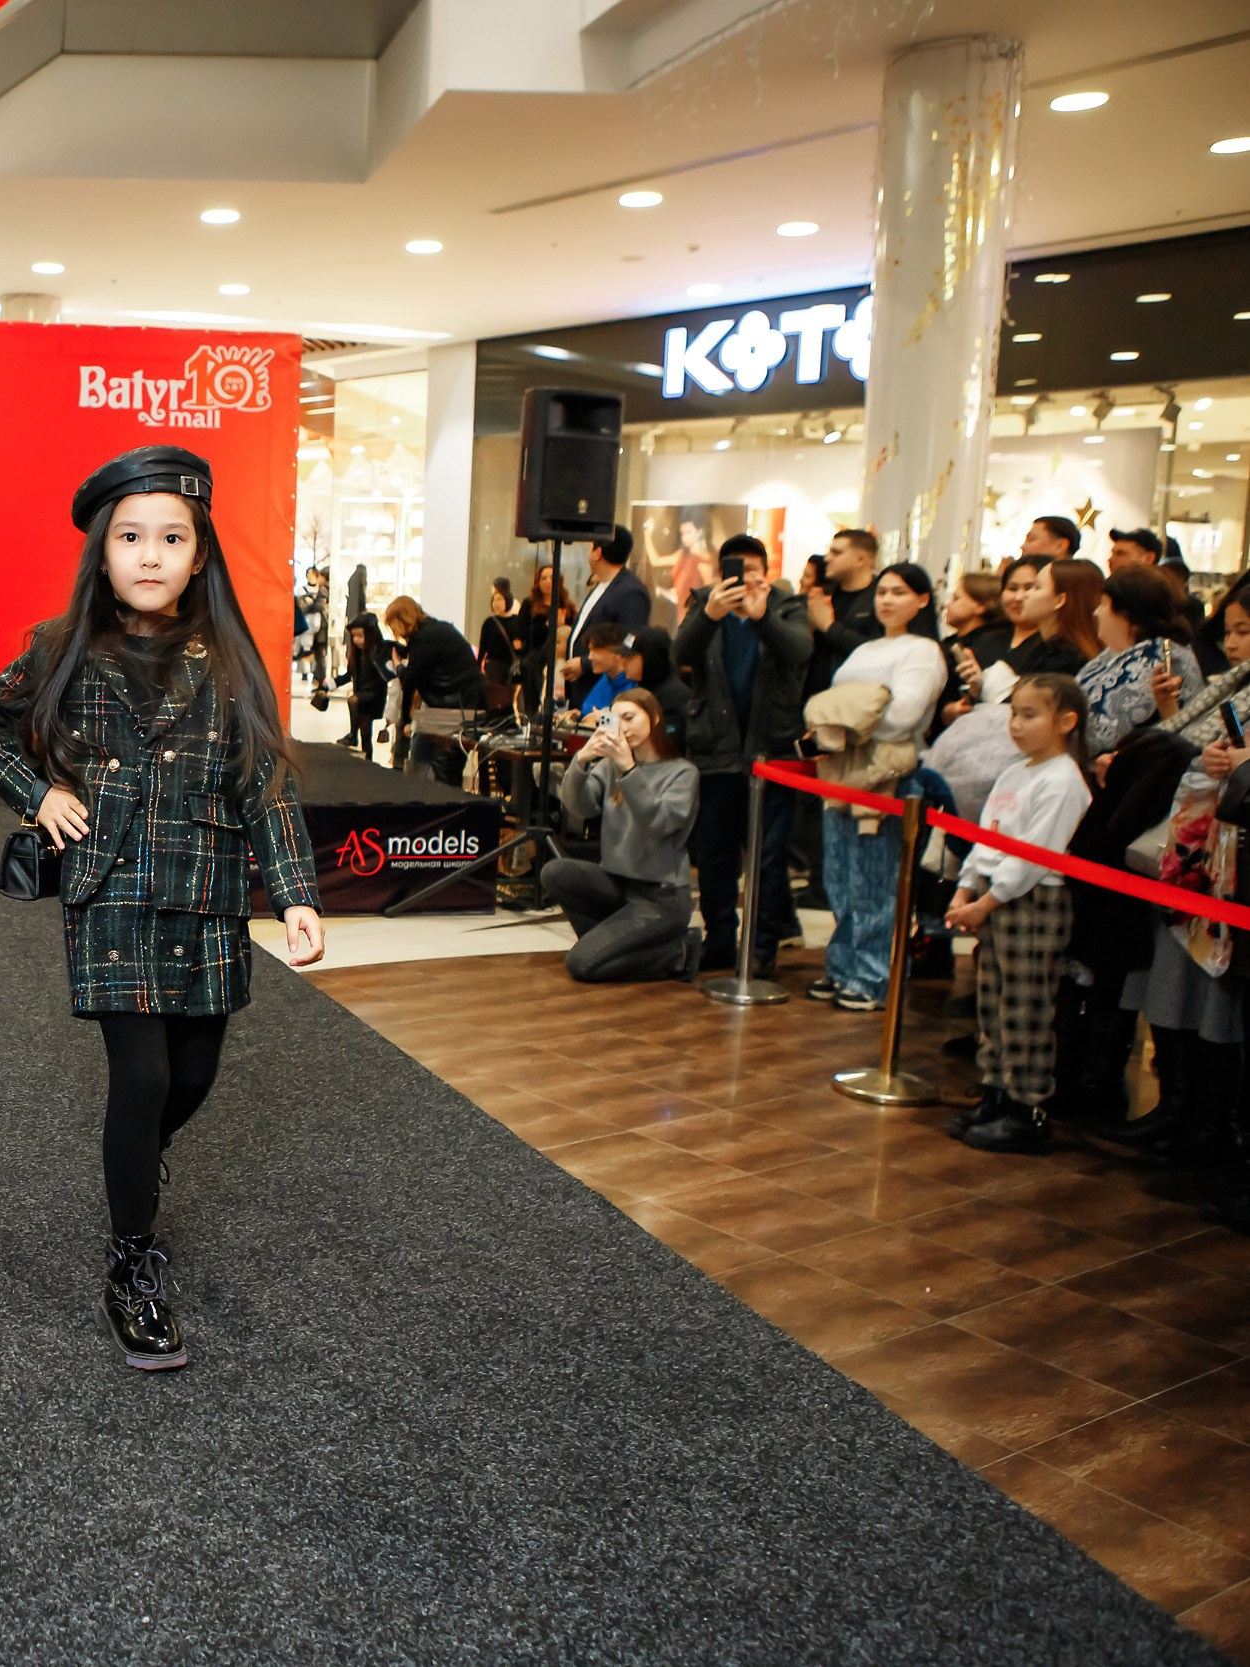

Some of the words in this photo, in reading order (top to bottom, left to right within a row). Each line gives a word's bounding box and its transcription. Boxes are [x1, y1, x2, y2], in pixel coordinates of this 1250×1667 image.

[78, 365, 187, 427] Batyr
[168, 410, 221, 429] mall
[336, 828, 385, 876] AS
[388, 829, 480, 856] models
